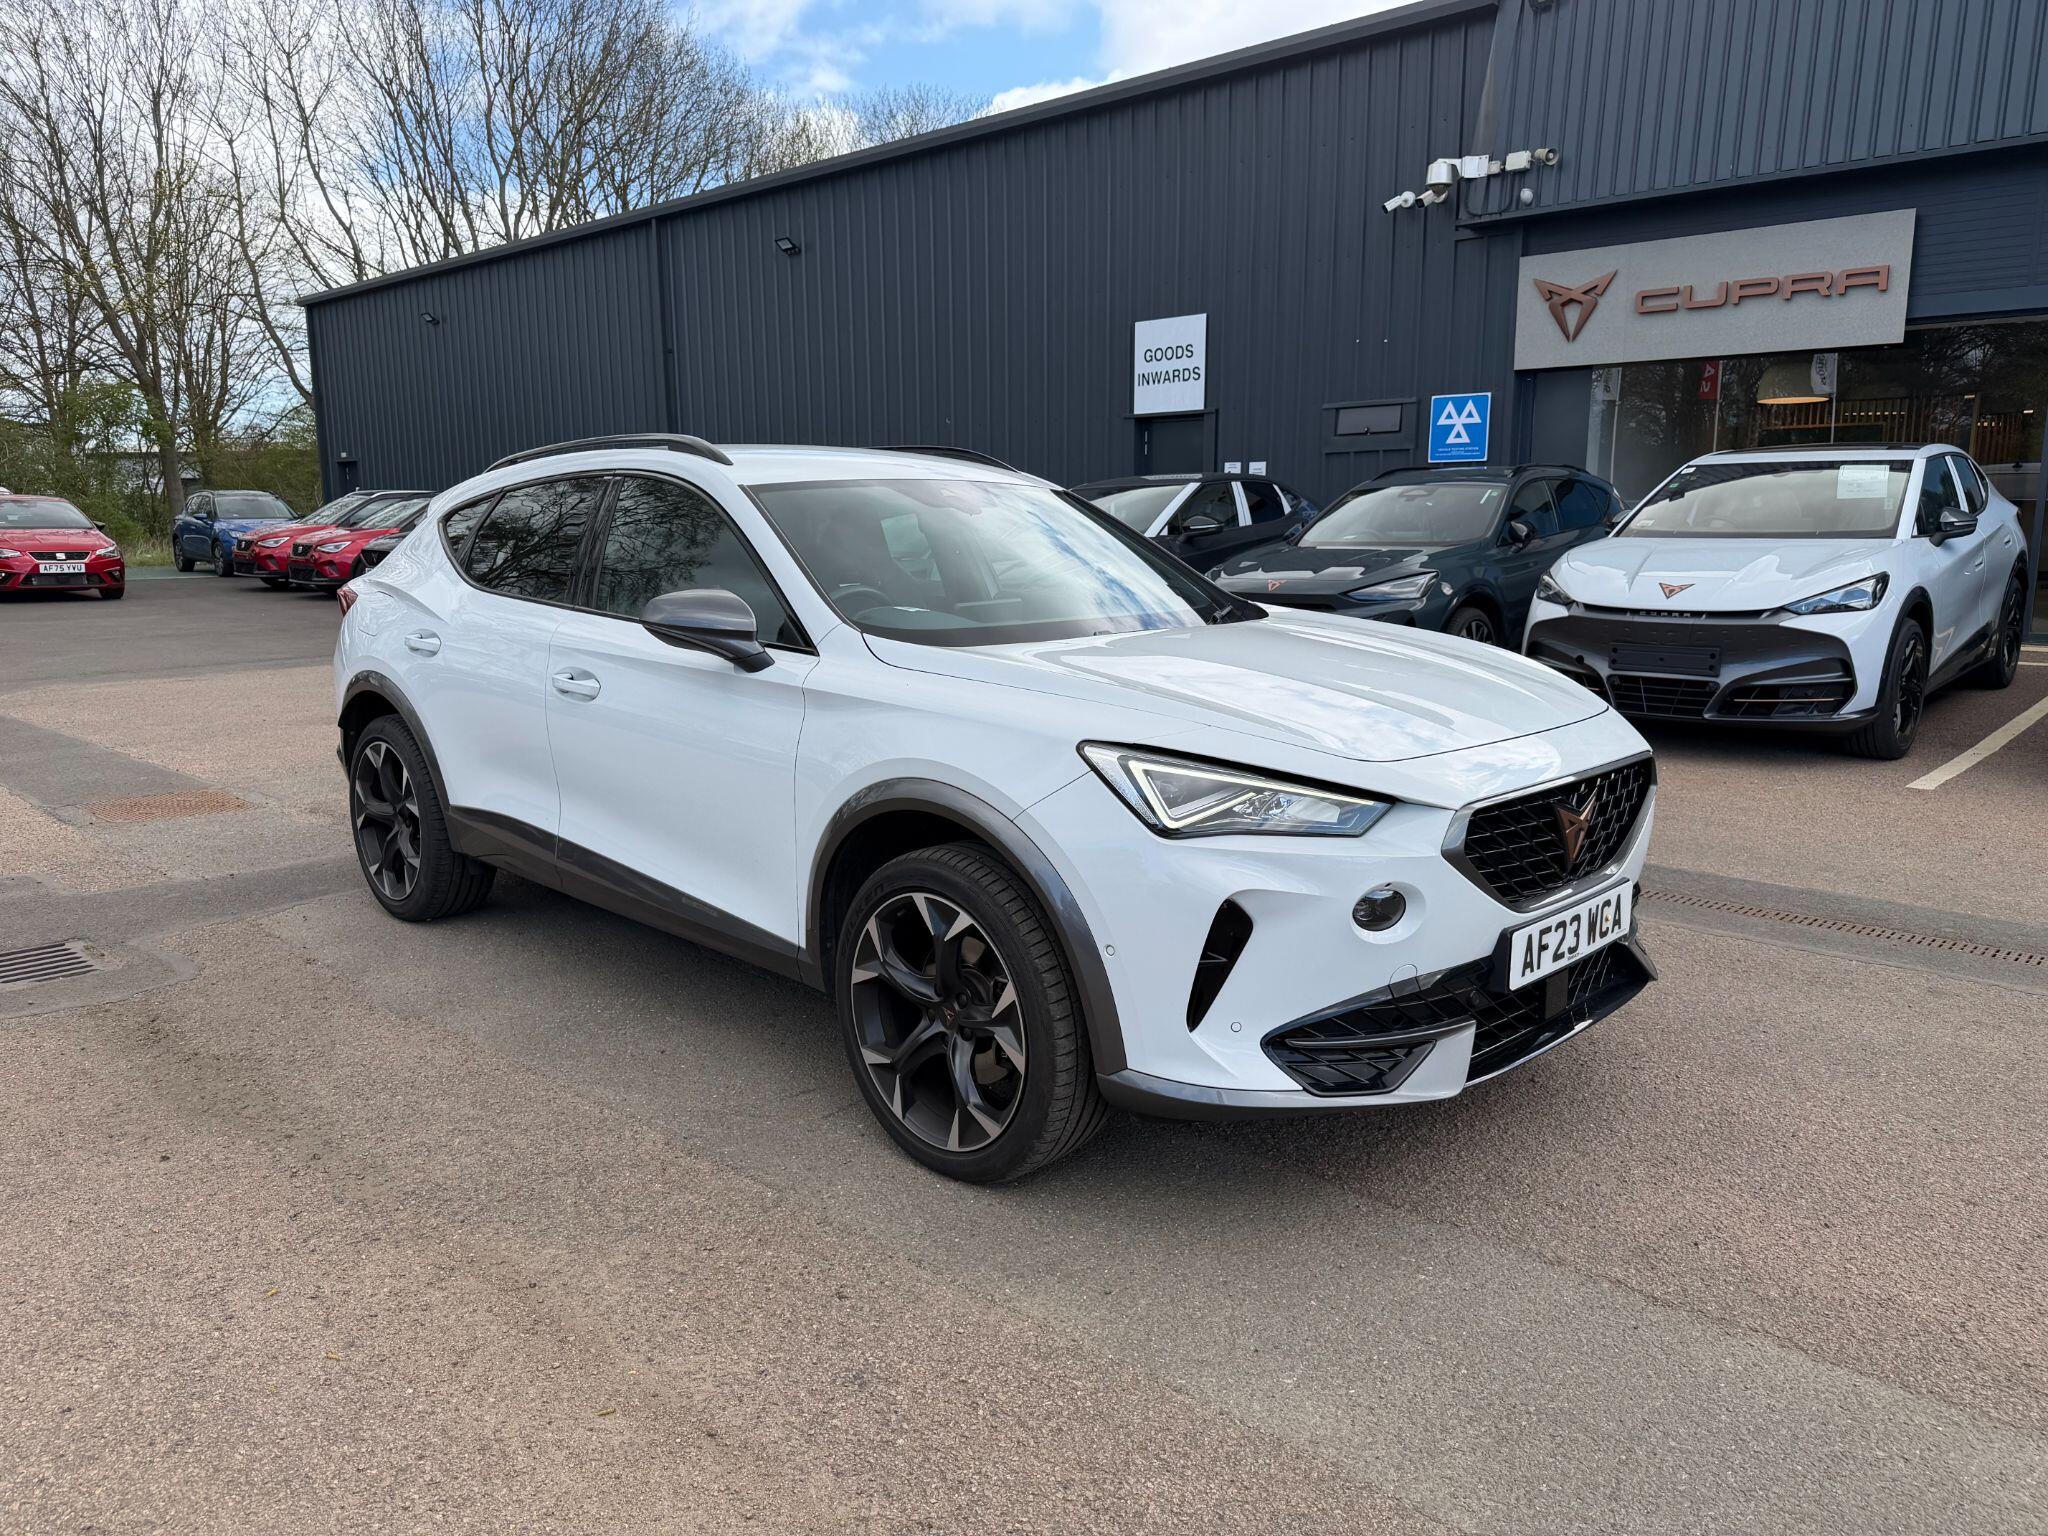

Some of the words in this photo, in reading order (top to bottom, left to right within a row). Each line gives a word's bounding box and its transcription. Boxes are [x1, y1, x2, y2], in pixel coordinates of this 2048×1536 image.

[1635, 264, 1890, 314] CUPRA
[1144, 343, 1194, 363] GOODS
[1137, 366, 1201, 387] INWARDS
[43, 564, 65, 572] AF75
[66, 564, 82, 572] YVU
[1521, 914, 1581, 977] AF23
[1587, 893, 1622, 947] WCA
